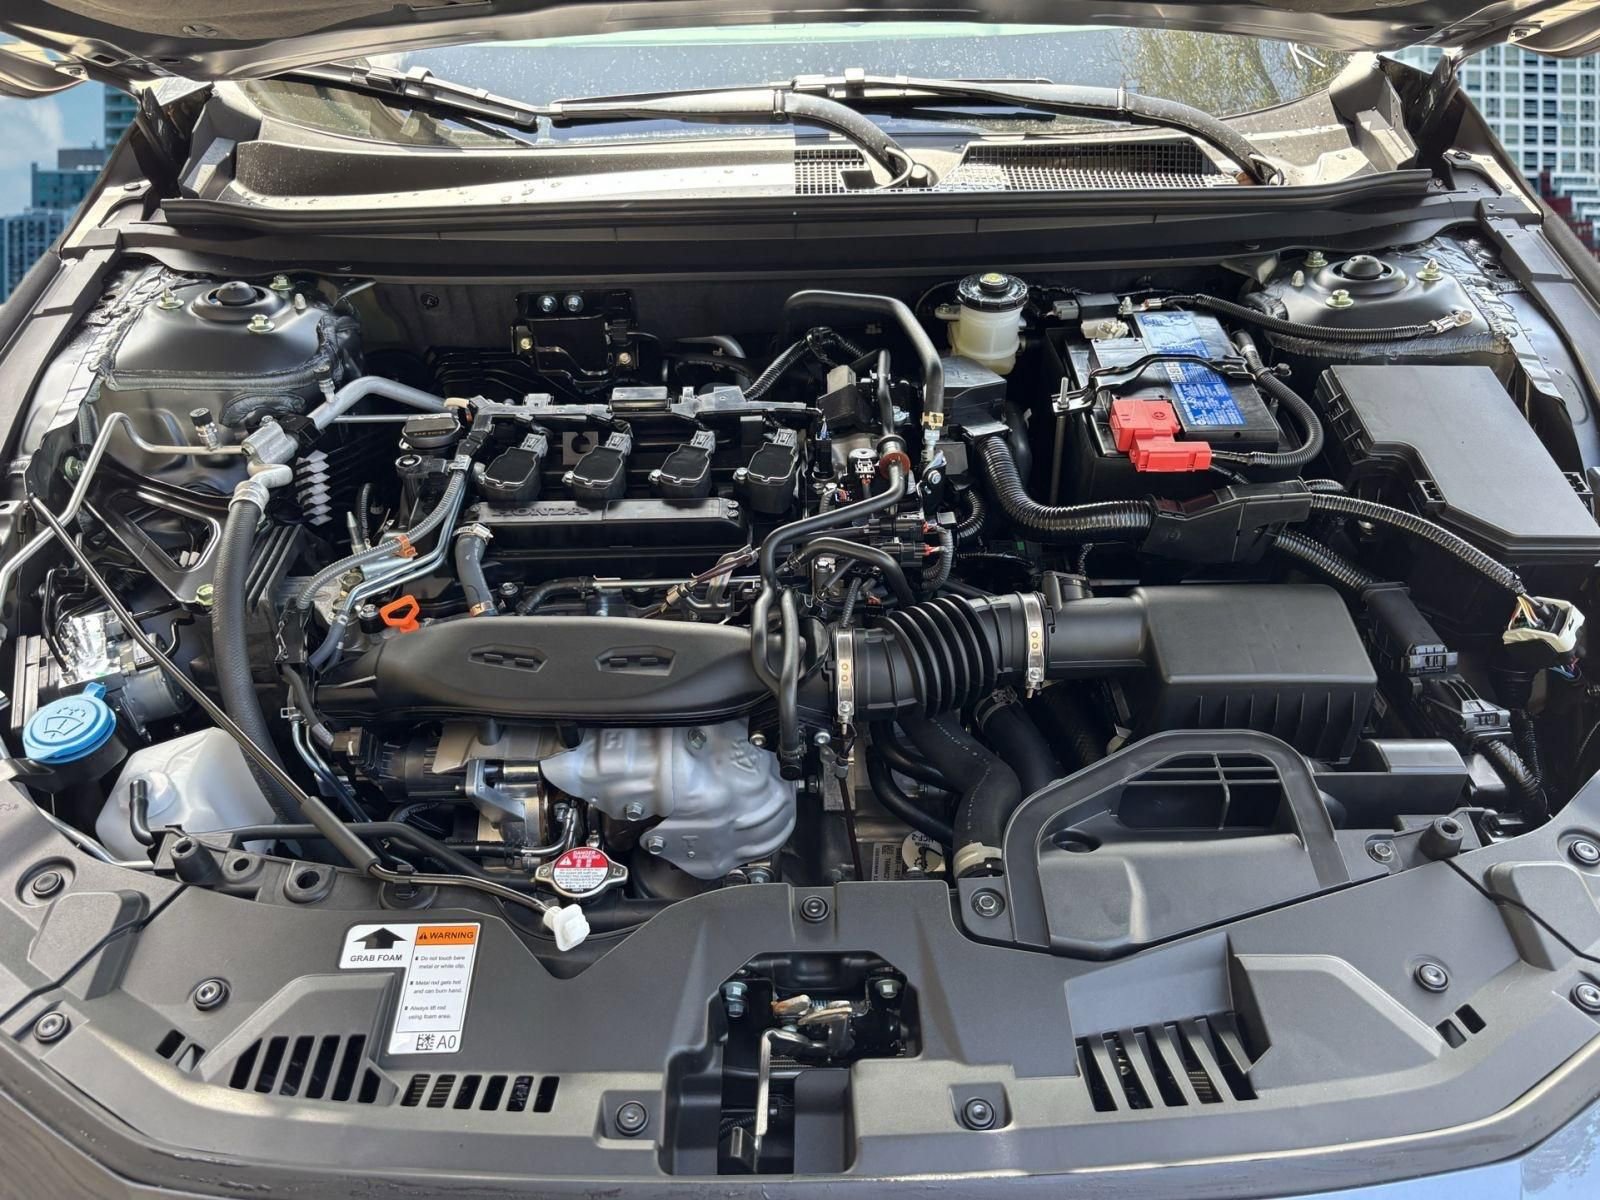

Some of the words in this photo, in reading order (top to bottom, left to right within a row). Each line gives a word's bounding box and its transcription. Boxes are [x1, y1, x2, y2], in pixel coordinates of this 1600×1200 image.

[491, 507, 590, 517] HONDA
[430, 931, 474, 939] WARNING
[436, 1034, 457, 1049] A0
